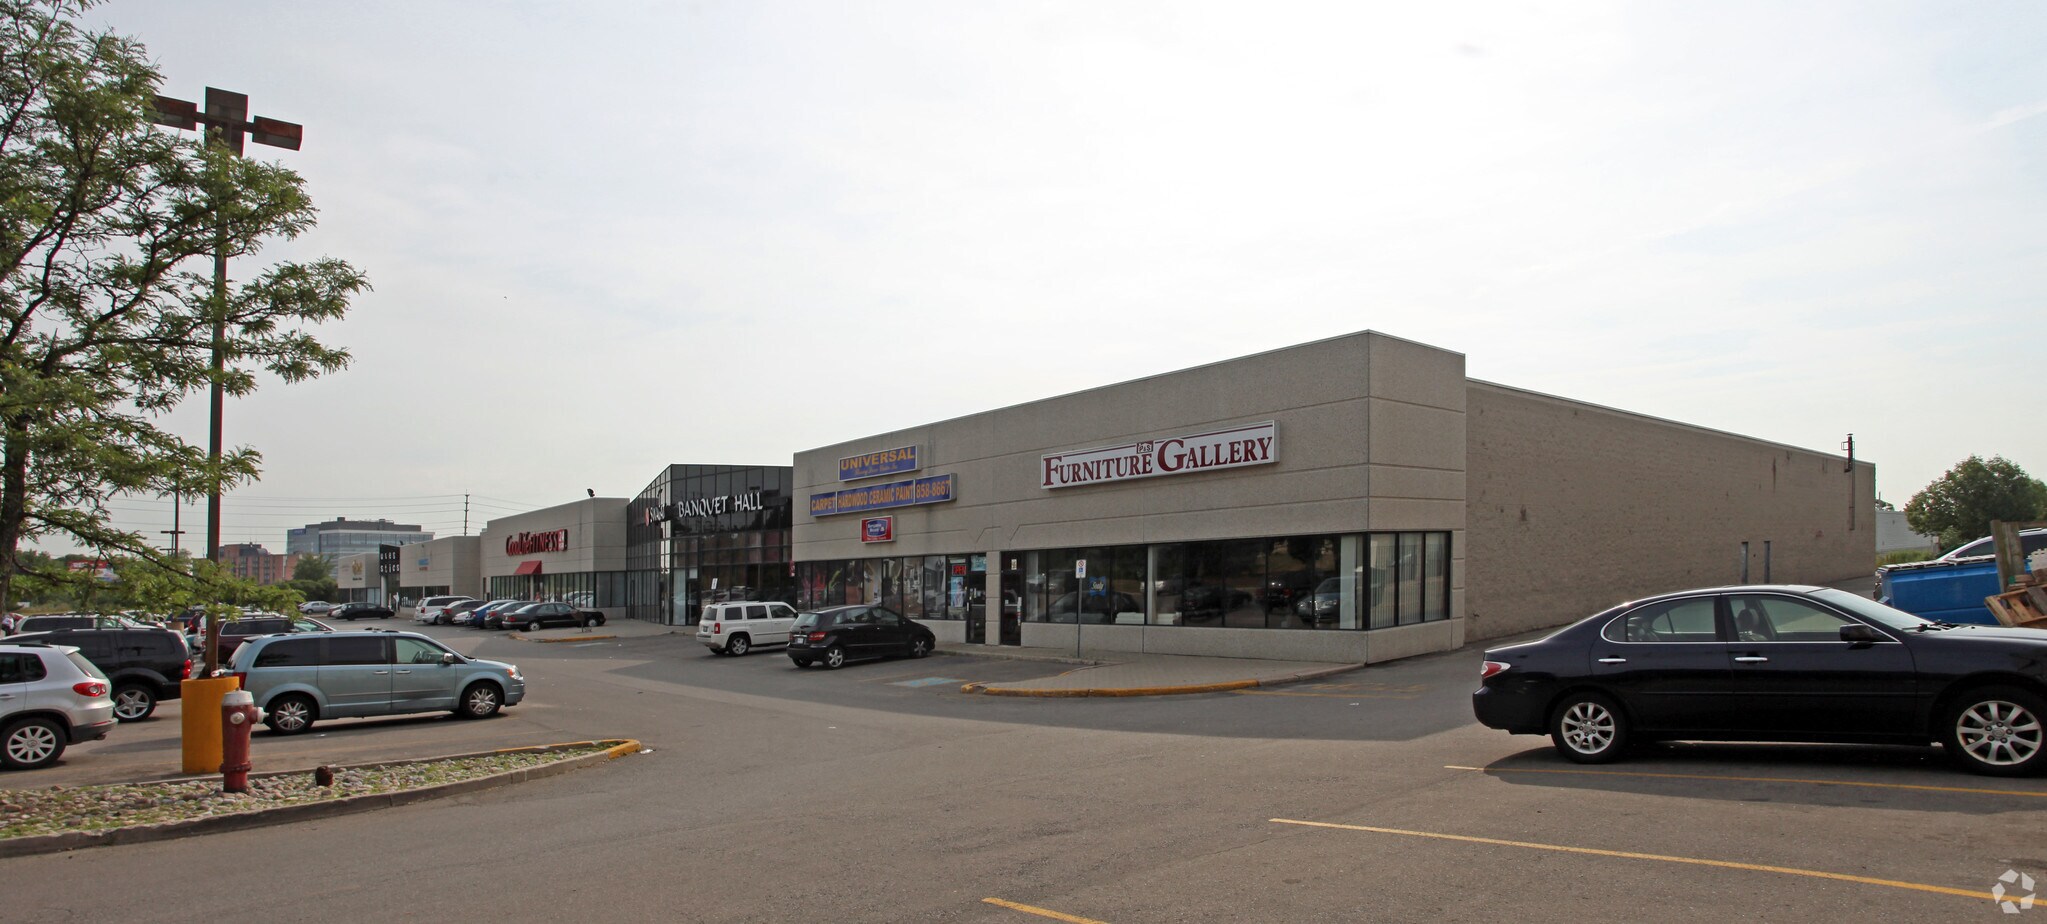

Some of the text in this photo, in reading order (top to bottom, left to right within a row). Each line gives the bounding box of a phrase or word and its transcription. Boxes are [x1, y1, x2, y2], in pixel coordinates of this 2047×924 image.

[840, 447, 915, 471] UNIVERSAL
[1043, 436, 1273, 486] FURNITURE GALLERY
[678, 495, 728, 518] BANQUET
[734, 491, 763, 511] HALL
[811, 480, 951, 512] CARPET HARDWOOD CERAMIC PAINT 858-8667
